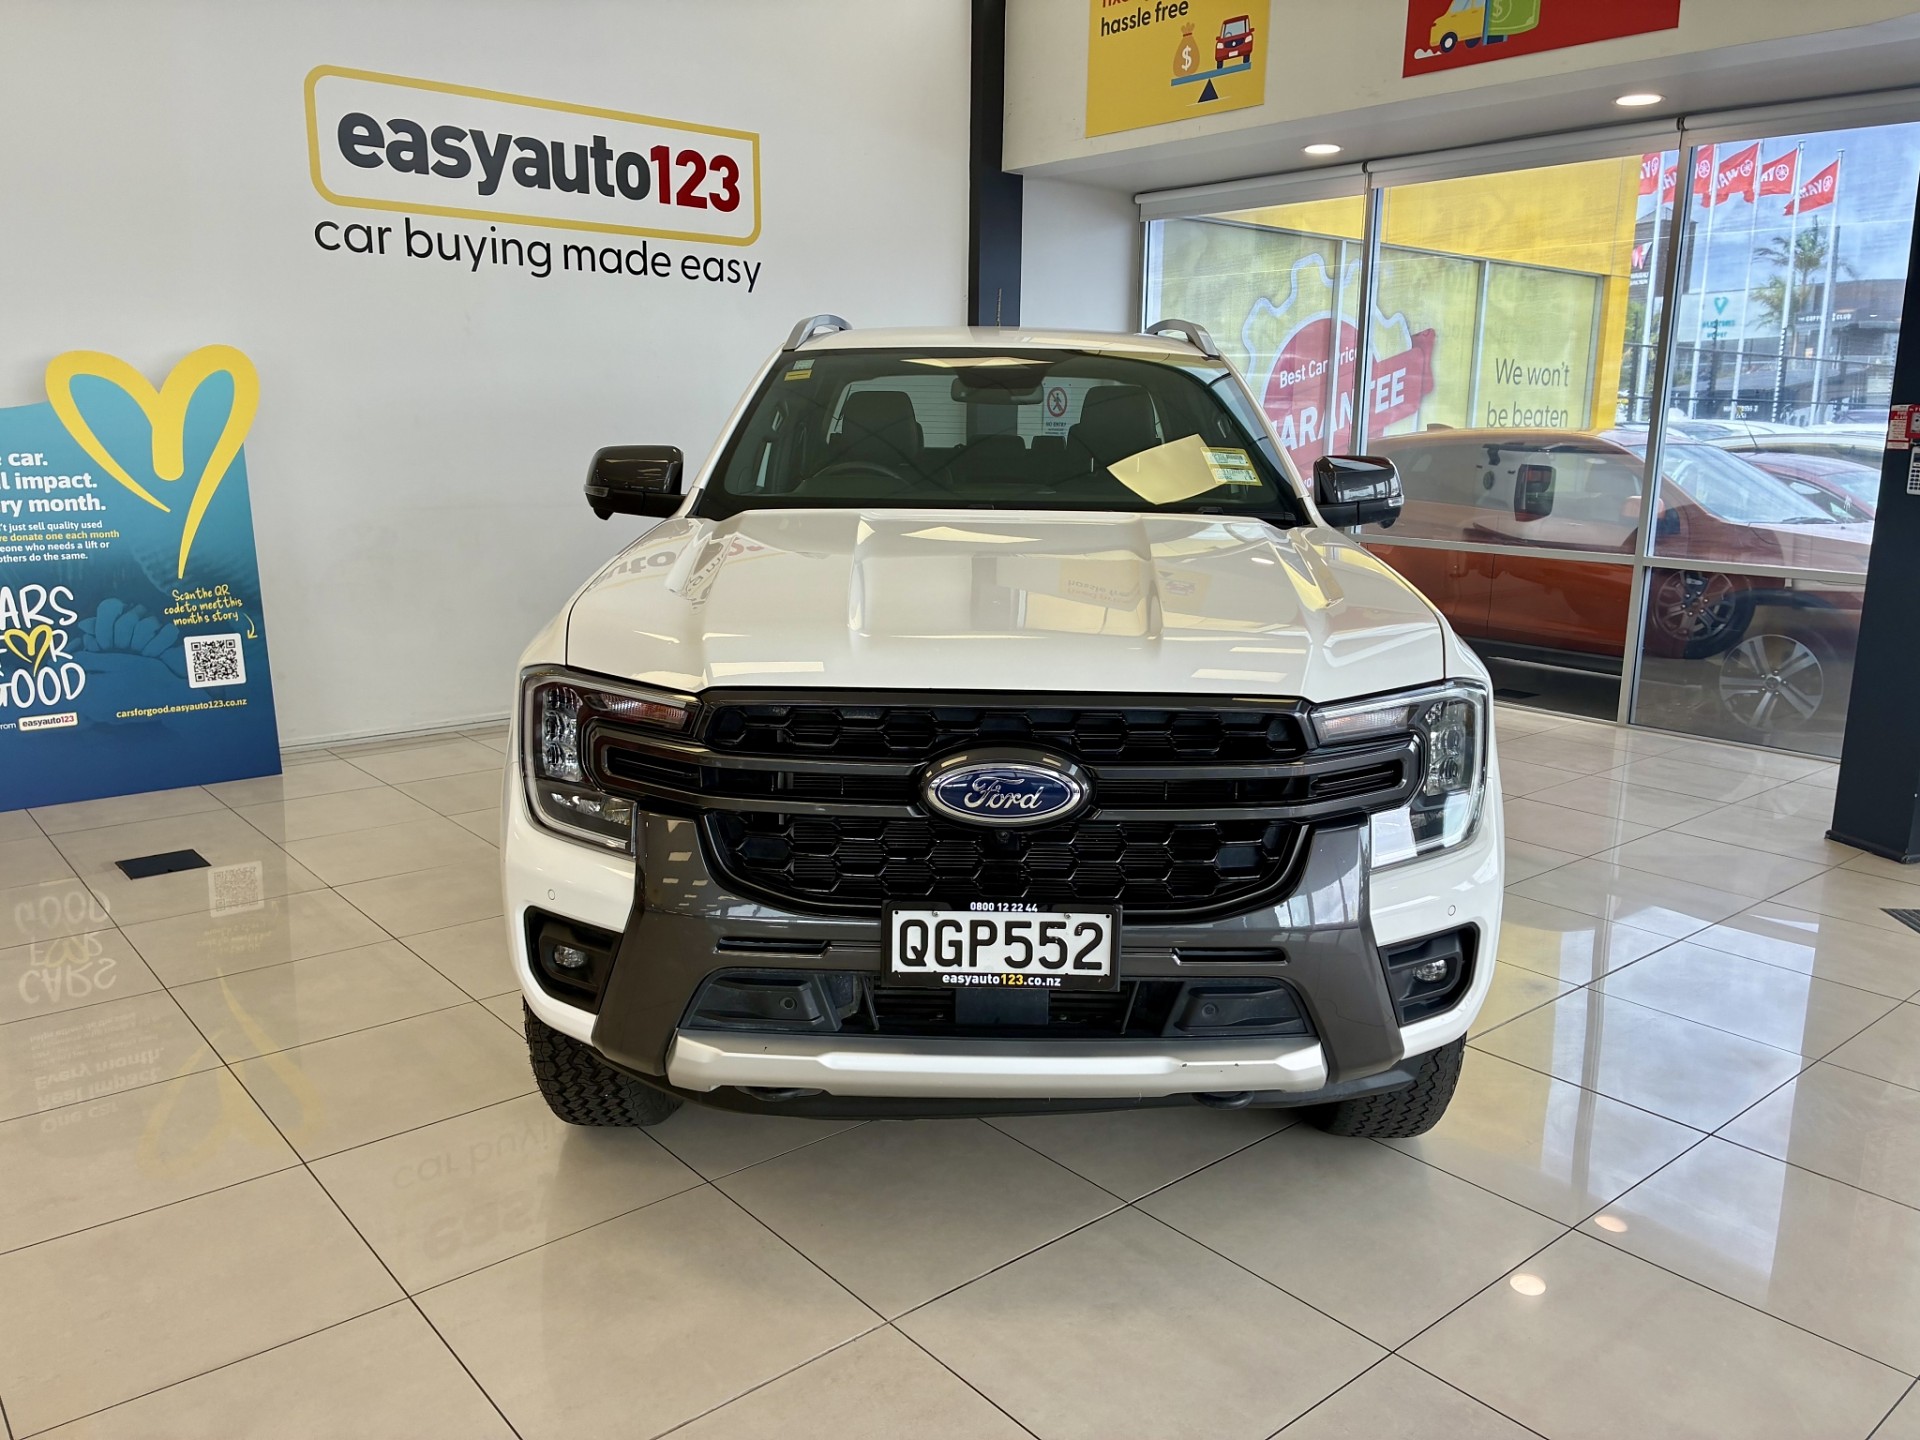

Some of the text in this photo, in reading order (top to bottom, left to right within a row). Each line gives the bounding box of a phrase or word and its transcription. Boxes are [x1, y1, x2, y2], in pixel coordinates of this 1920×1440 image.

[1101, 0, 1189, 37] hassle free
[337, 112, 741, 213] easyauto123
[314, 217, 762, 293] car buying made easy
[1279, 346, 1357, 389] Best Car ric
[1495, 357, 1570, 387] We won't
[1487, 401, 1569, 428] be beaten
[8, 452, 48, 467] car.
[14, 472, 98, 494] impact.
[0, 493, 107, 518] ry month.
[9, 523, 26, 533] just
[28, 522, 46, 531] sell
[47, 520, 79, 532] quality
[81, 520, 103, 529] used
[10, 532, 43, 542] donate
[45, 533, 63, 541] one
[65, 531, 88, 540] each
[90, 529, 120, 539] month
[0, 545, 23, 553] eone
[25, 543, 46, 552] who
[47, 541, 75, 550] needs
[84, 540, 98, 549] lift
[100, 541, 110, 549] or
[0, 552, 88, 564] others do the same.
[172, 584, 231, 602] Scan the QR
[0, 584, 78, 630] ARS
[164, 596, 243, 615] code to meet this
[212, 609, 239, 622] story
[116, 698, 248, 718] carsforgood.easyauto123.co.nz
[22, 715, 75, 728] easyauto123
[963, 775, 1043, 810] Ford
[970, 902, 1038, 912] 0800 12 22 44
[899, 919, 1104, 970] QGP552
[942, 973, 1061, 987] easyauto123.co.nz
